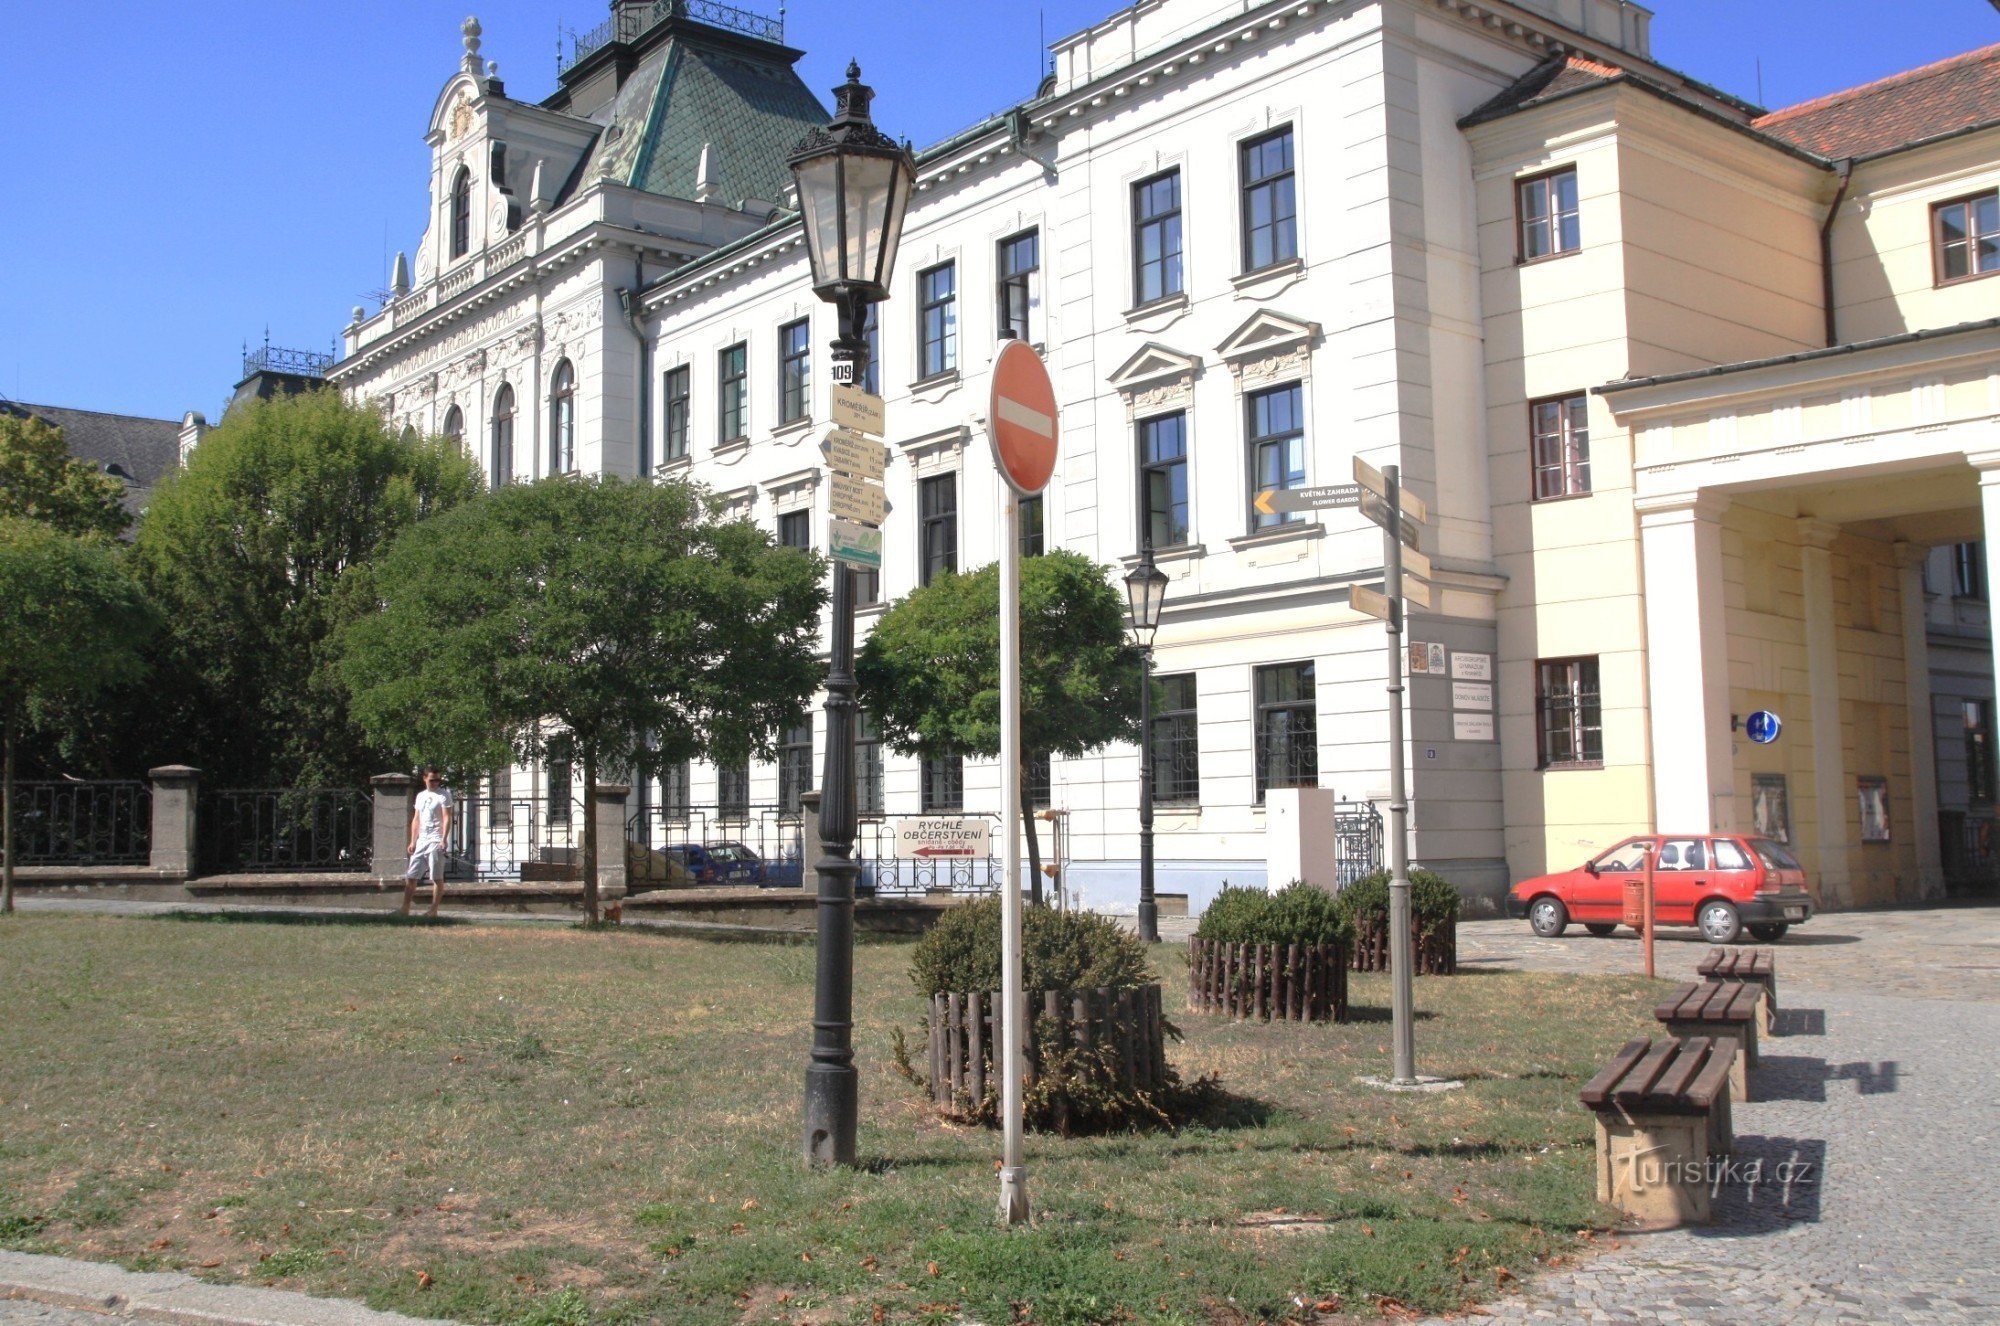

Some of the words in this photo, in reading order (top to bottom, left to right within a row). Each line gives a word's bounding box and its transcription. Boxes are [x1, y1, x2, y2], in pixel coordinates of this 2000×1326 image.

[832, 365, 852, 380] 109
[1300, 490, 1326, 498] KVĚTNÁ
[1327, 487, 1359, 496] ZAHRADA
[918, 820, 963, 830] RYCHLÉ
[903, 829, 983, 840] OBČERSTVENÍ
